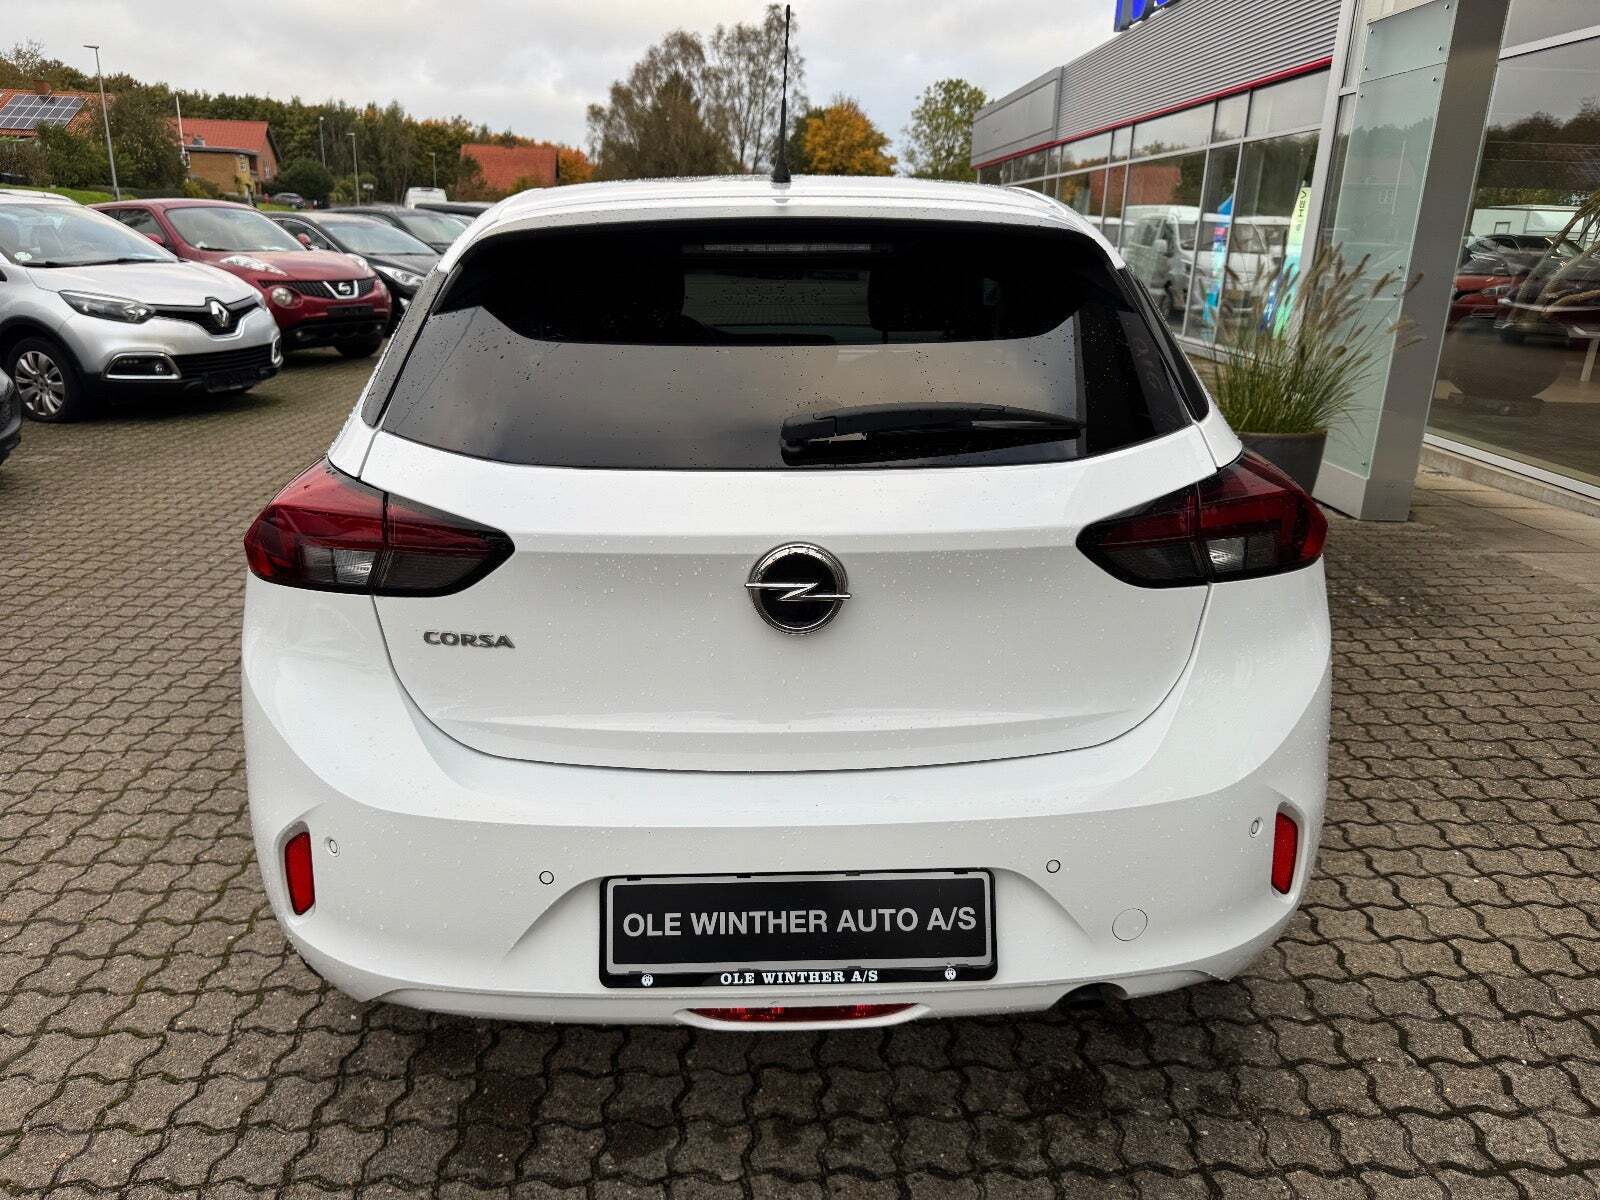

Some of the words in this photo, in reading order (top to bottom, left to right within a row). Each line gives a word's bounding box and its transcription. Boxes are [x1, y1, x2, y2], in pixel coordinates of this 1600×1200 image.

[423, 631, 516, 649] CORSA
[623, 912, 682, 937] OLE
[690, 909, 828, 936] WINTHER
[836, 907, 919, 933] AUTO
[927, 906, 977, 931] A/S
[720, 972, 755, 985] OLE
[762, 970, 846, 985] WINTHER
[851, 969, 879, 983] A/S
